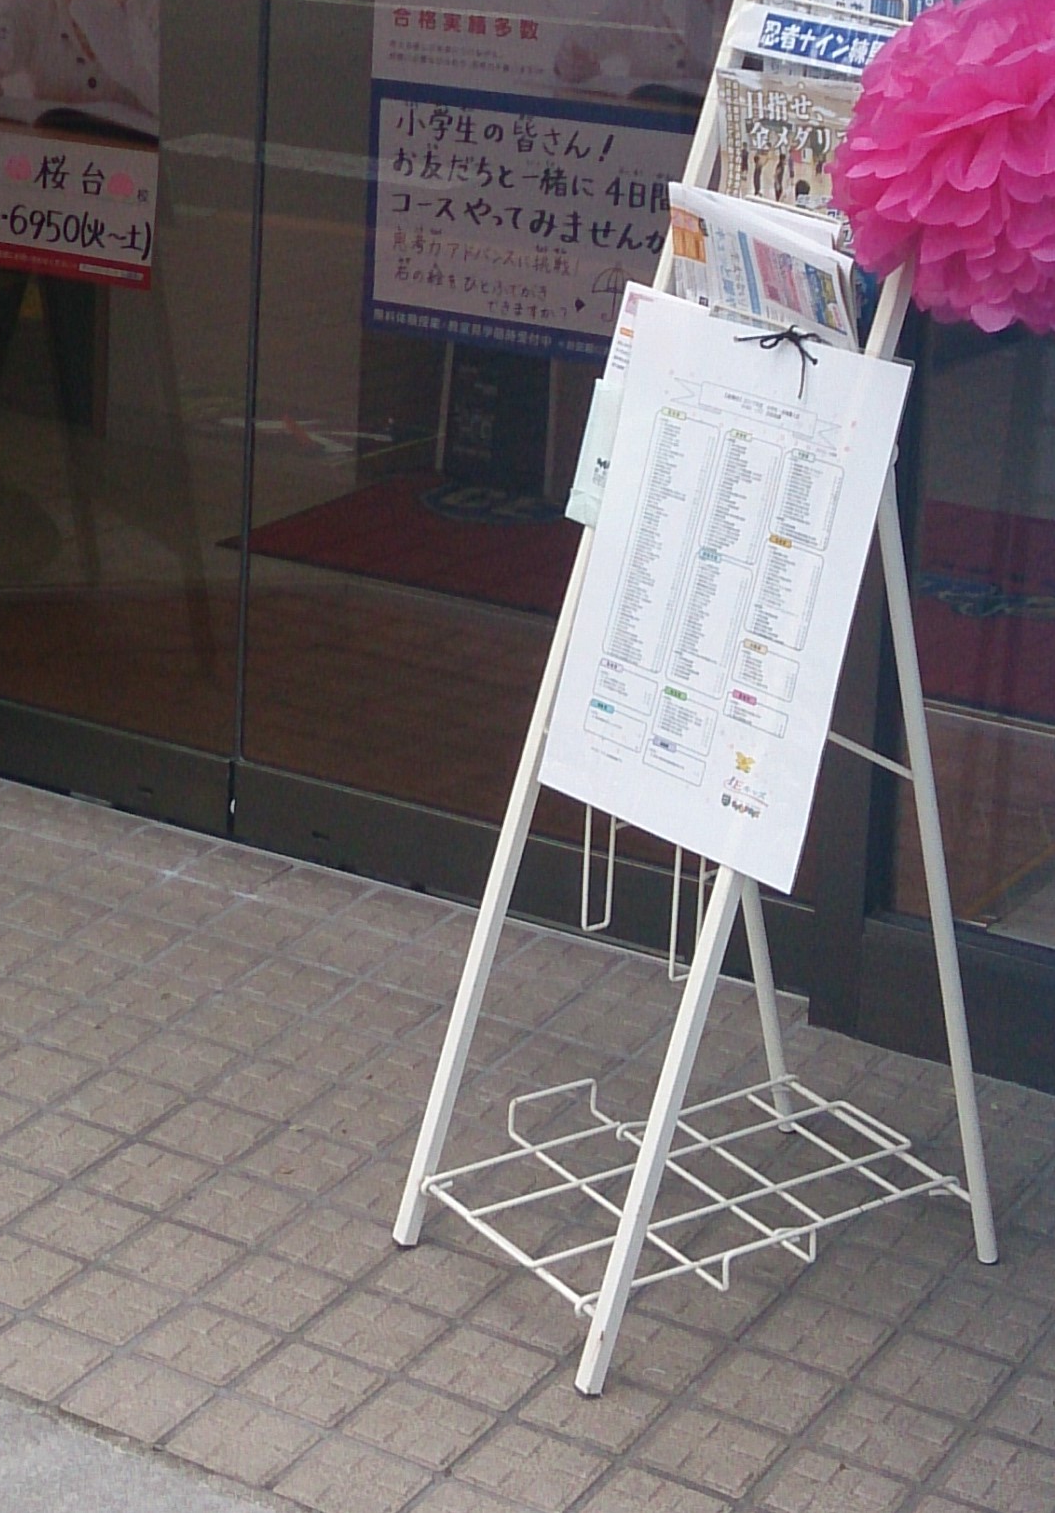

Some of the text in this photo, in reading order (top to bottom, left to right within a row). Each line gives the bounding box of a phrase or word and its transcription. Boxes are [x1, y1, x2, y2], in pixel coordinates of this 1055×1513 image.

[392, 6, 540, 42] 合格実績多数
[34, 154, 107, 197] 桜台
